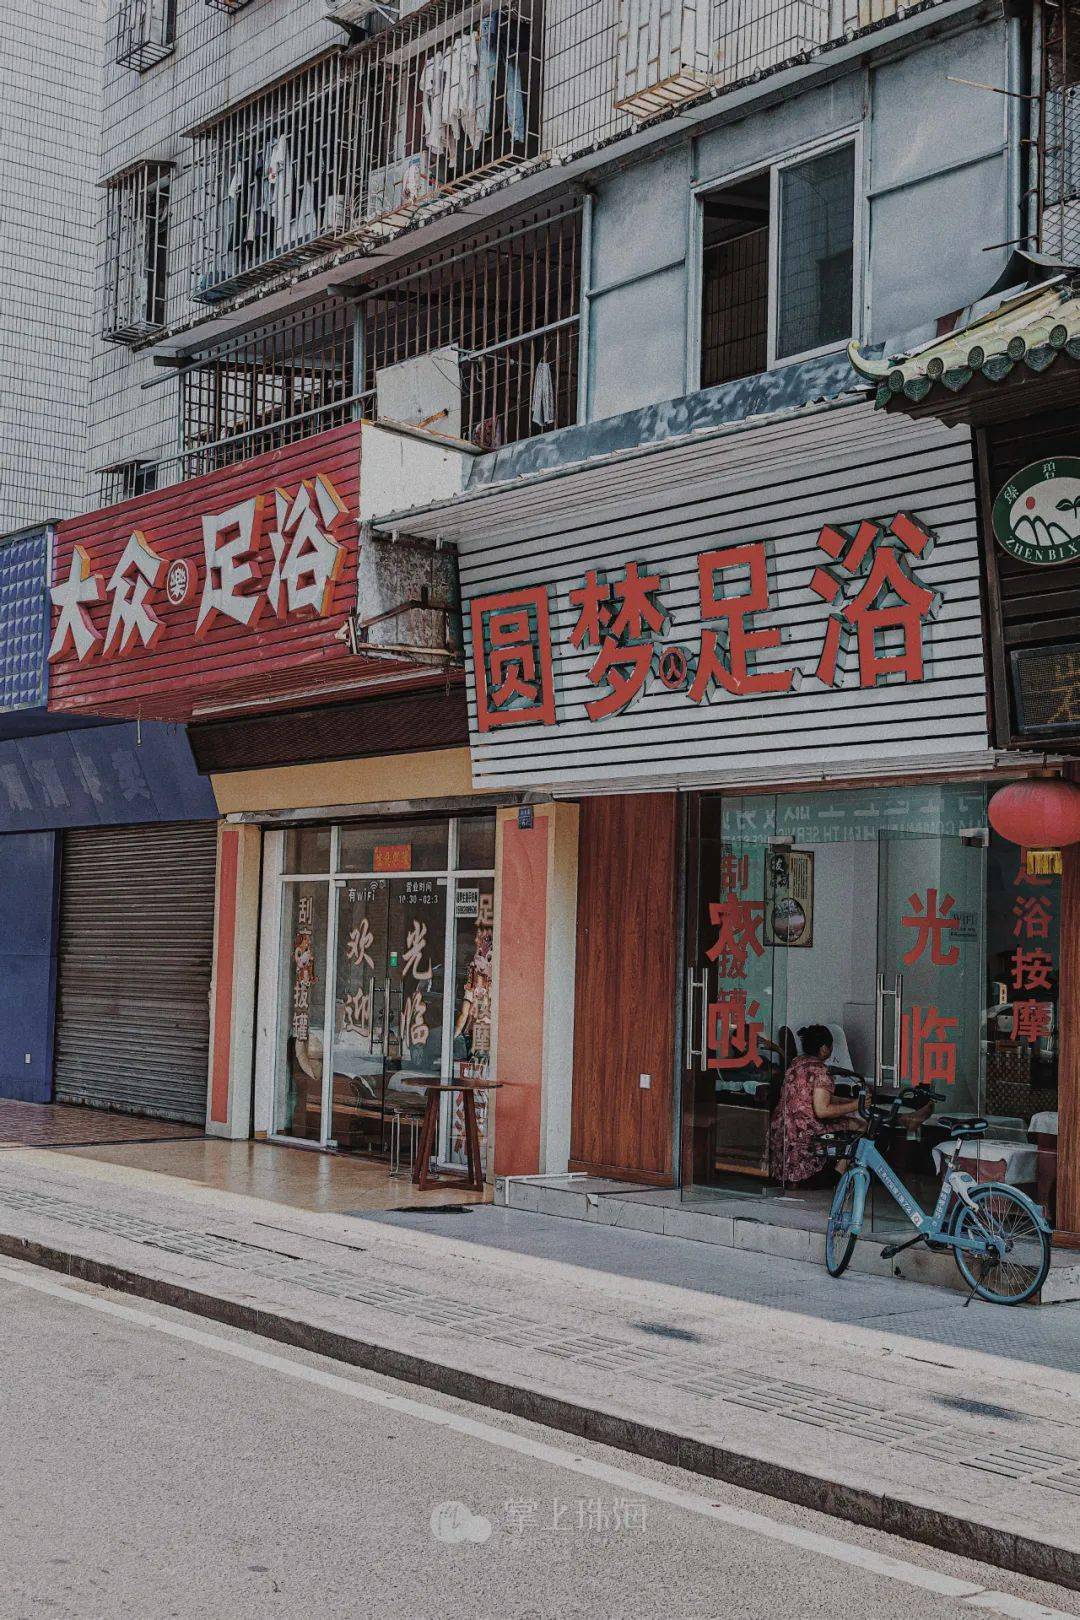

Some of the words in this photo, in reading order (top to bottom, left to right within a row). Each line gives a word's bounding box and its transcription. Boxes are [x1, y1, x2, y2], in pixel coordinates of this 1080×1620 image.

[293, 896, 313, 1041] 刮拔罐
[902, 888, 960, 1087] 光临
